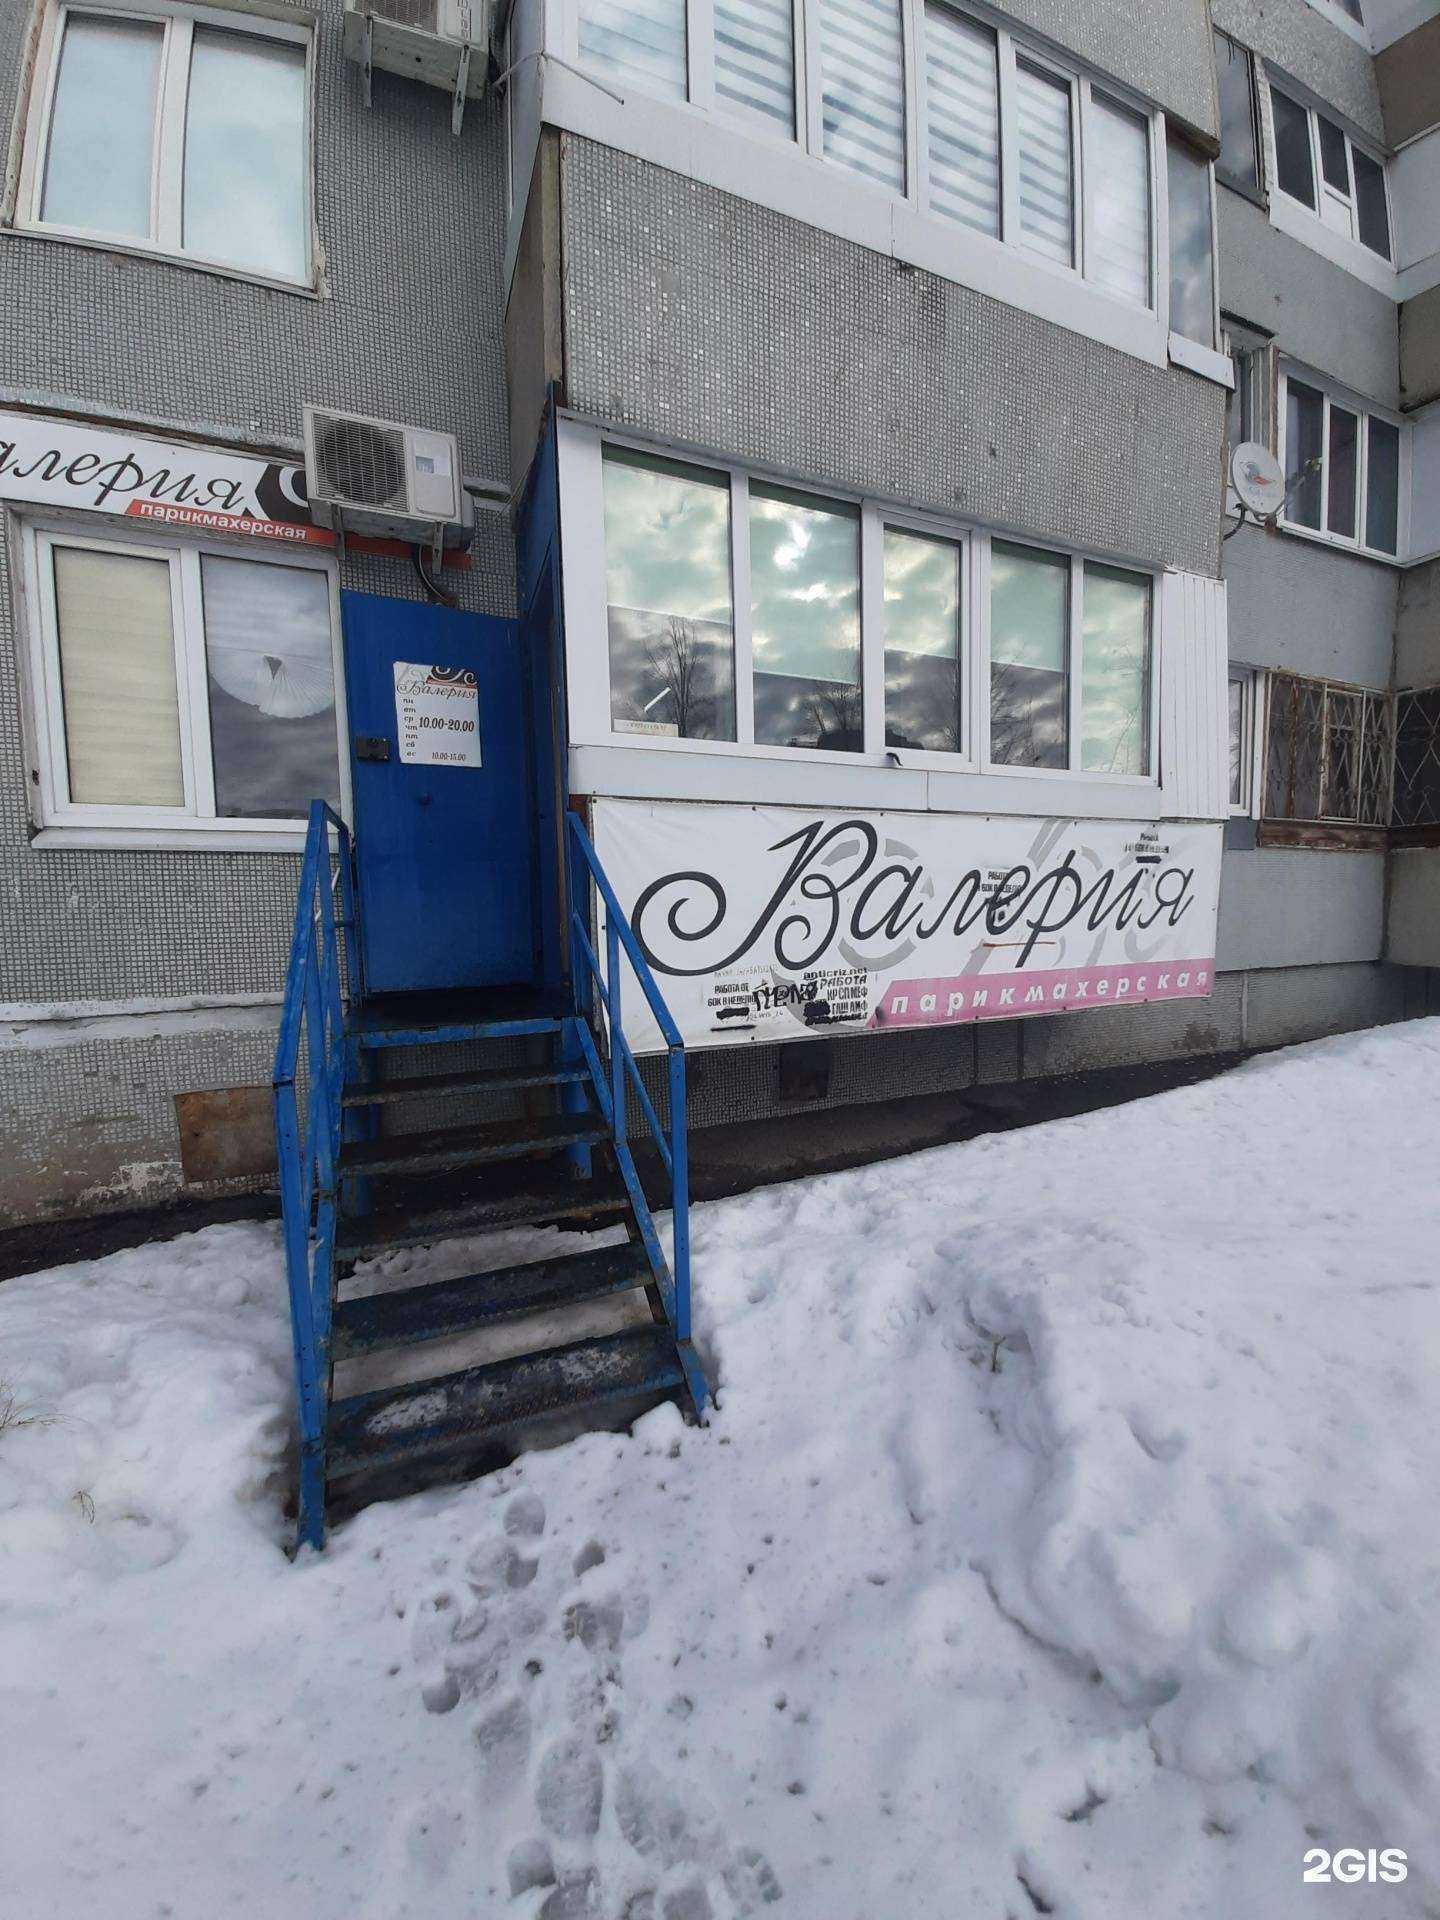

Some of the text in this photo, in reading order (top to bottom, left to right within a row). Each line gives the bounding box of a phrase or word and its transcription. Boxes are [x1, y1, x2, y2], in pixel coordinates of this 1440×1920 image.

[140, 503, 307, 539] парикмахерская
[397, 679, 477, 700] Валерия
[419, 716, 475, 732] 10.00-20.00
[632, 820, 1195, 976] Валерия
[820, 975, 867, 990] РАБОТА
[891, 971, 1208, 1018] парикмахерская
